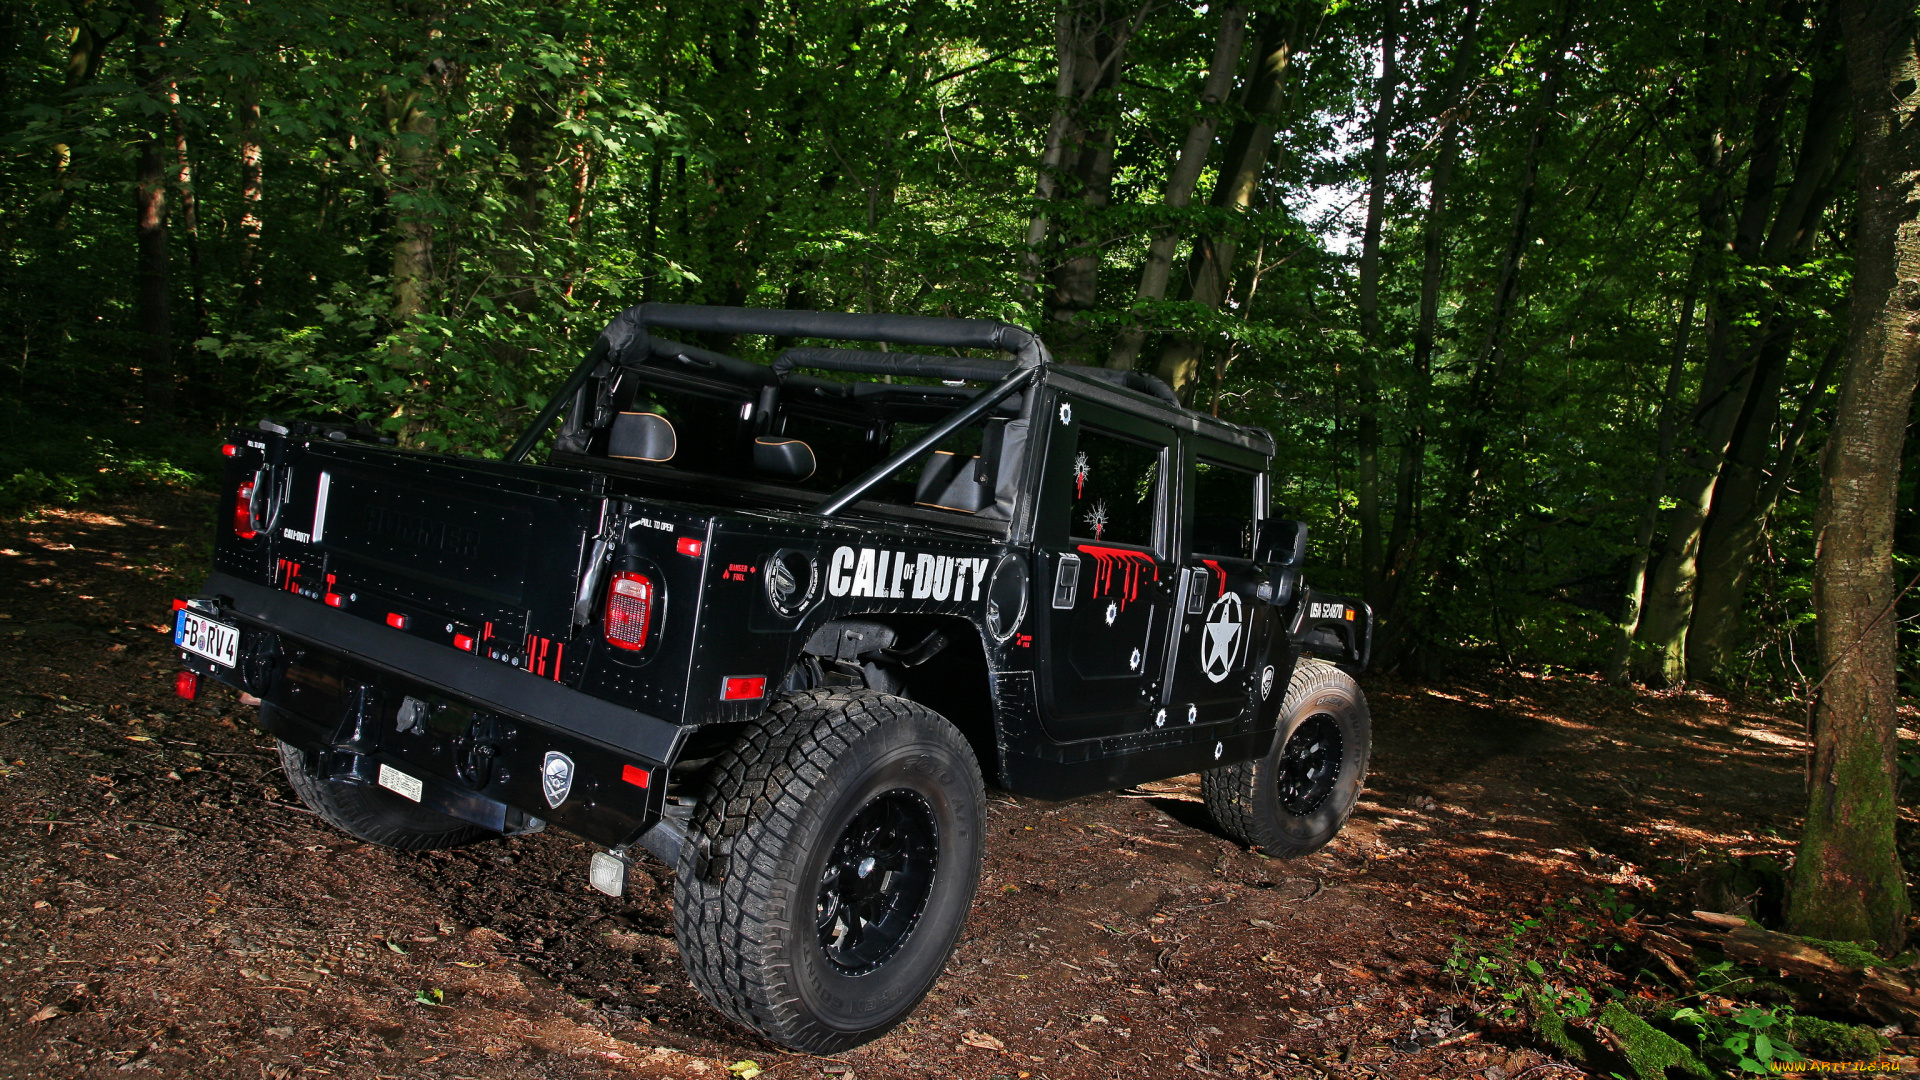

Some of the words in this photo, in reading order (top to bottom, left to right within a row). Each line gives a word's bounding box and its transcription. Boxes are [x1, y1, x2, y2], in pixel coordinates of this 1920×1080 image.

[363, 504, 480, 558] HUMMER
[641, 517, 652, 528] PULL
[653, 520, 660, 529] TO
[660, 521, 674, 532] OPEN
[829, 546, 905, 599] CALL
[903, 563, 914, 580] OF
[912, 553, 989, 601] DUTY
[1310, 602, 1322, 618] USA
[182, 617, 199, 647] FB
[206, 626, 225, 657] RV
[226, 634, 234, 661] 4
[902, 753, 956, 786] TOYO
